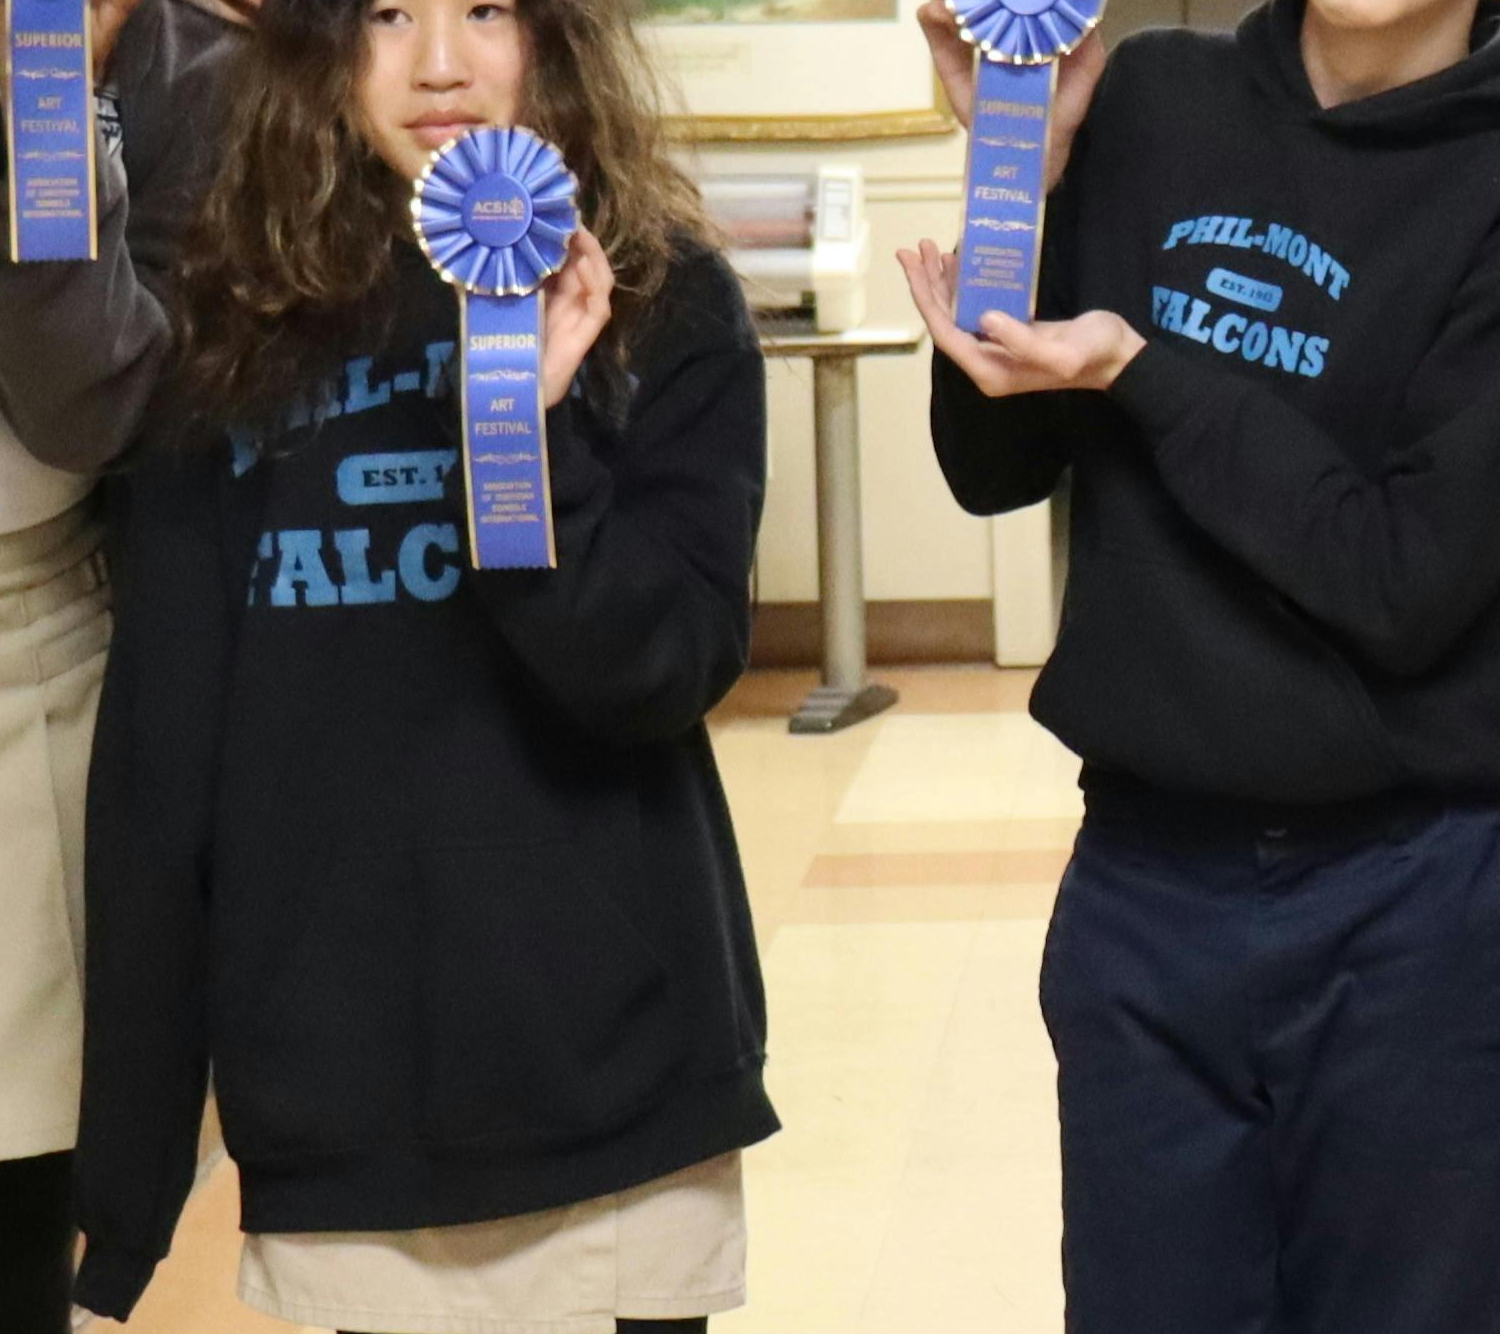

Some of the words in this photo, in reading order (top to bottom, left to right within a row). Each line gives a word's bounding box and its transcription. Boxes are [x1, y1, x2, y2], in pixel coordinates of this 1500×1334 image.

[15, 32, 84, 48] SUPERIOR
[37, 95, 63, 109] ART
[979, 99, 1045, 119] SUPERIOR
[20, 119, 81, 135] FESTIVAL
[993, 165, 1019, 179] ART
[974, 185, 1033, 204] FESTIVAL
[1162, 215, 1350, 301] PHIL-MONT
[1152, 285, 1330, 378] FALCONS
[469, 333, 537, 351] SUPERIOR
[490, 397, 516, 412] ART
[474, 421, 532, 435] FESTIVAL
